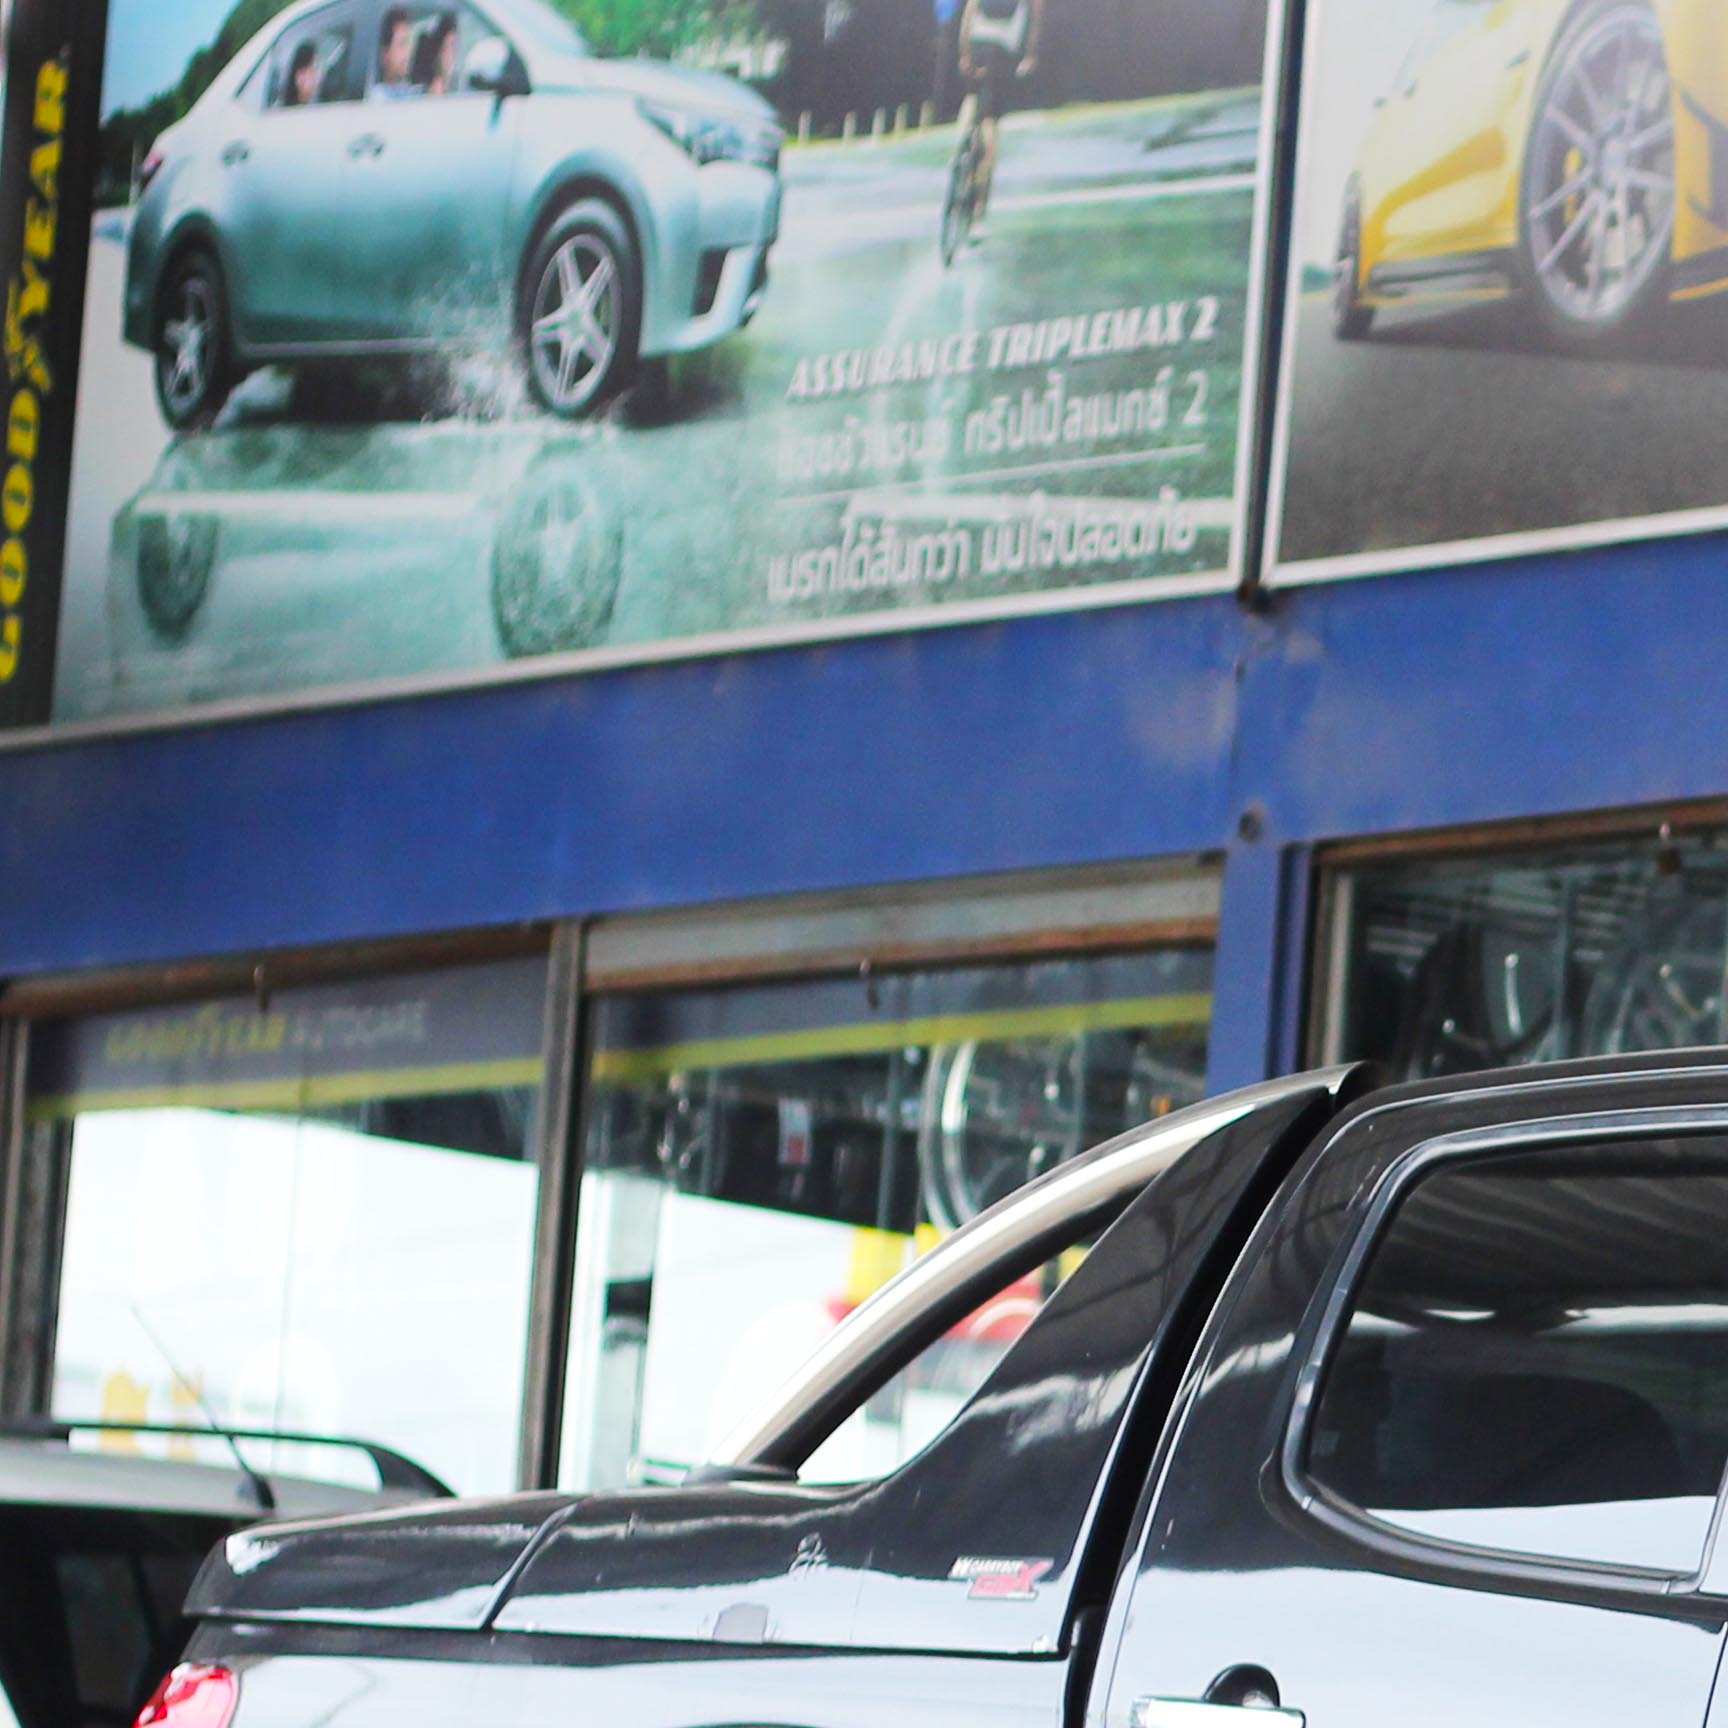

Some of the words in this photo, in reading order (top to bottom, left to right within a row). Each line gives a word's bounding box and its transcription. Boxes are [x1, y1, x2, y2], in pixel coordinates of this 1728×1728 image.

[785, 332, 979, 400] ASSURANCE
[987, 301, 1189, 371] TRIPLEMAX
[1190, 296, 1219, 340] 2
[1183, 369, 1210, 427] 2
